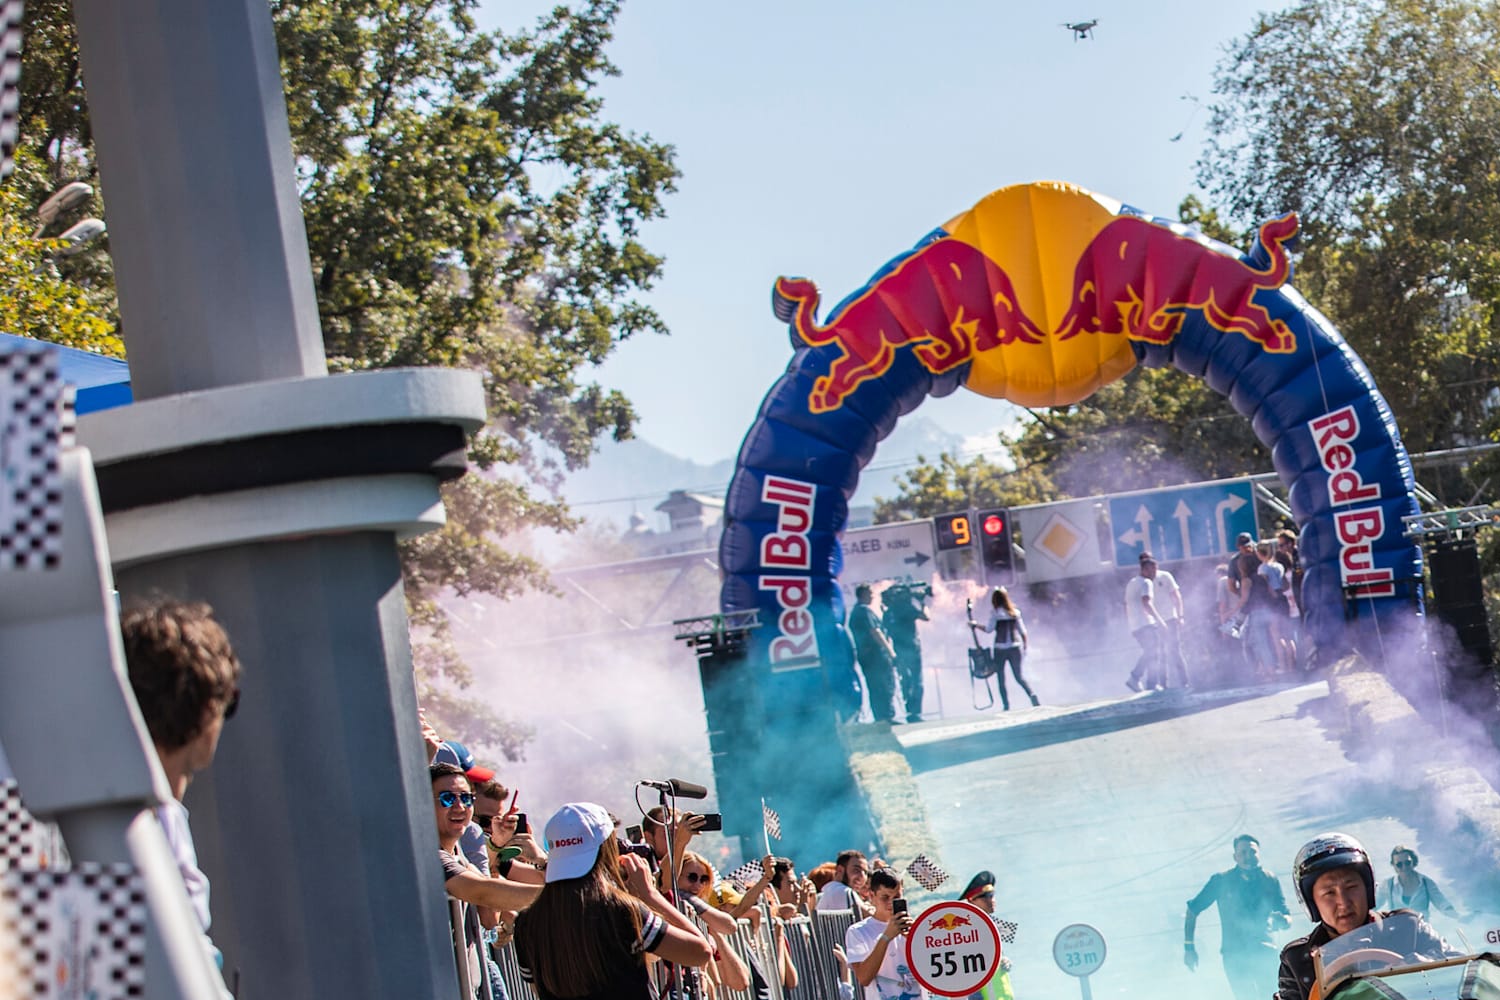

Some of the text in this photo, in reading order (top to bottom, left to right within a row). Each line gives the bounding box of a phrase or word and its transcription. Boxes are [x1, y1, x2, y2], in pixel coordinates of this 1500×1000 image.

[1307, 405, 1395, 599] Red Bull
[951, 517, 971, 545] 9
[759, 474, 821, 673] Red Bull
[556, 837, 583, 848] BOSCH
[925, 930, 979, 949] Red Bull
[931, 951, 986, 978] 55 m
[1066, 951, 1097, 968] 33 m
